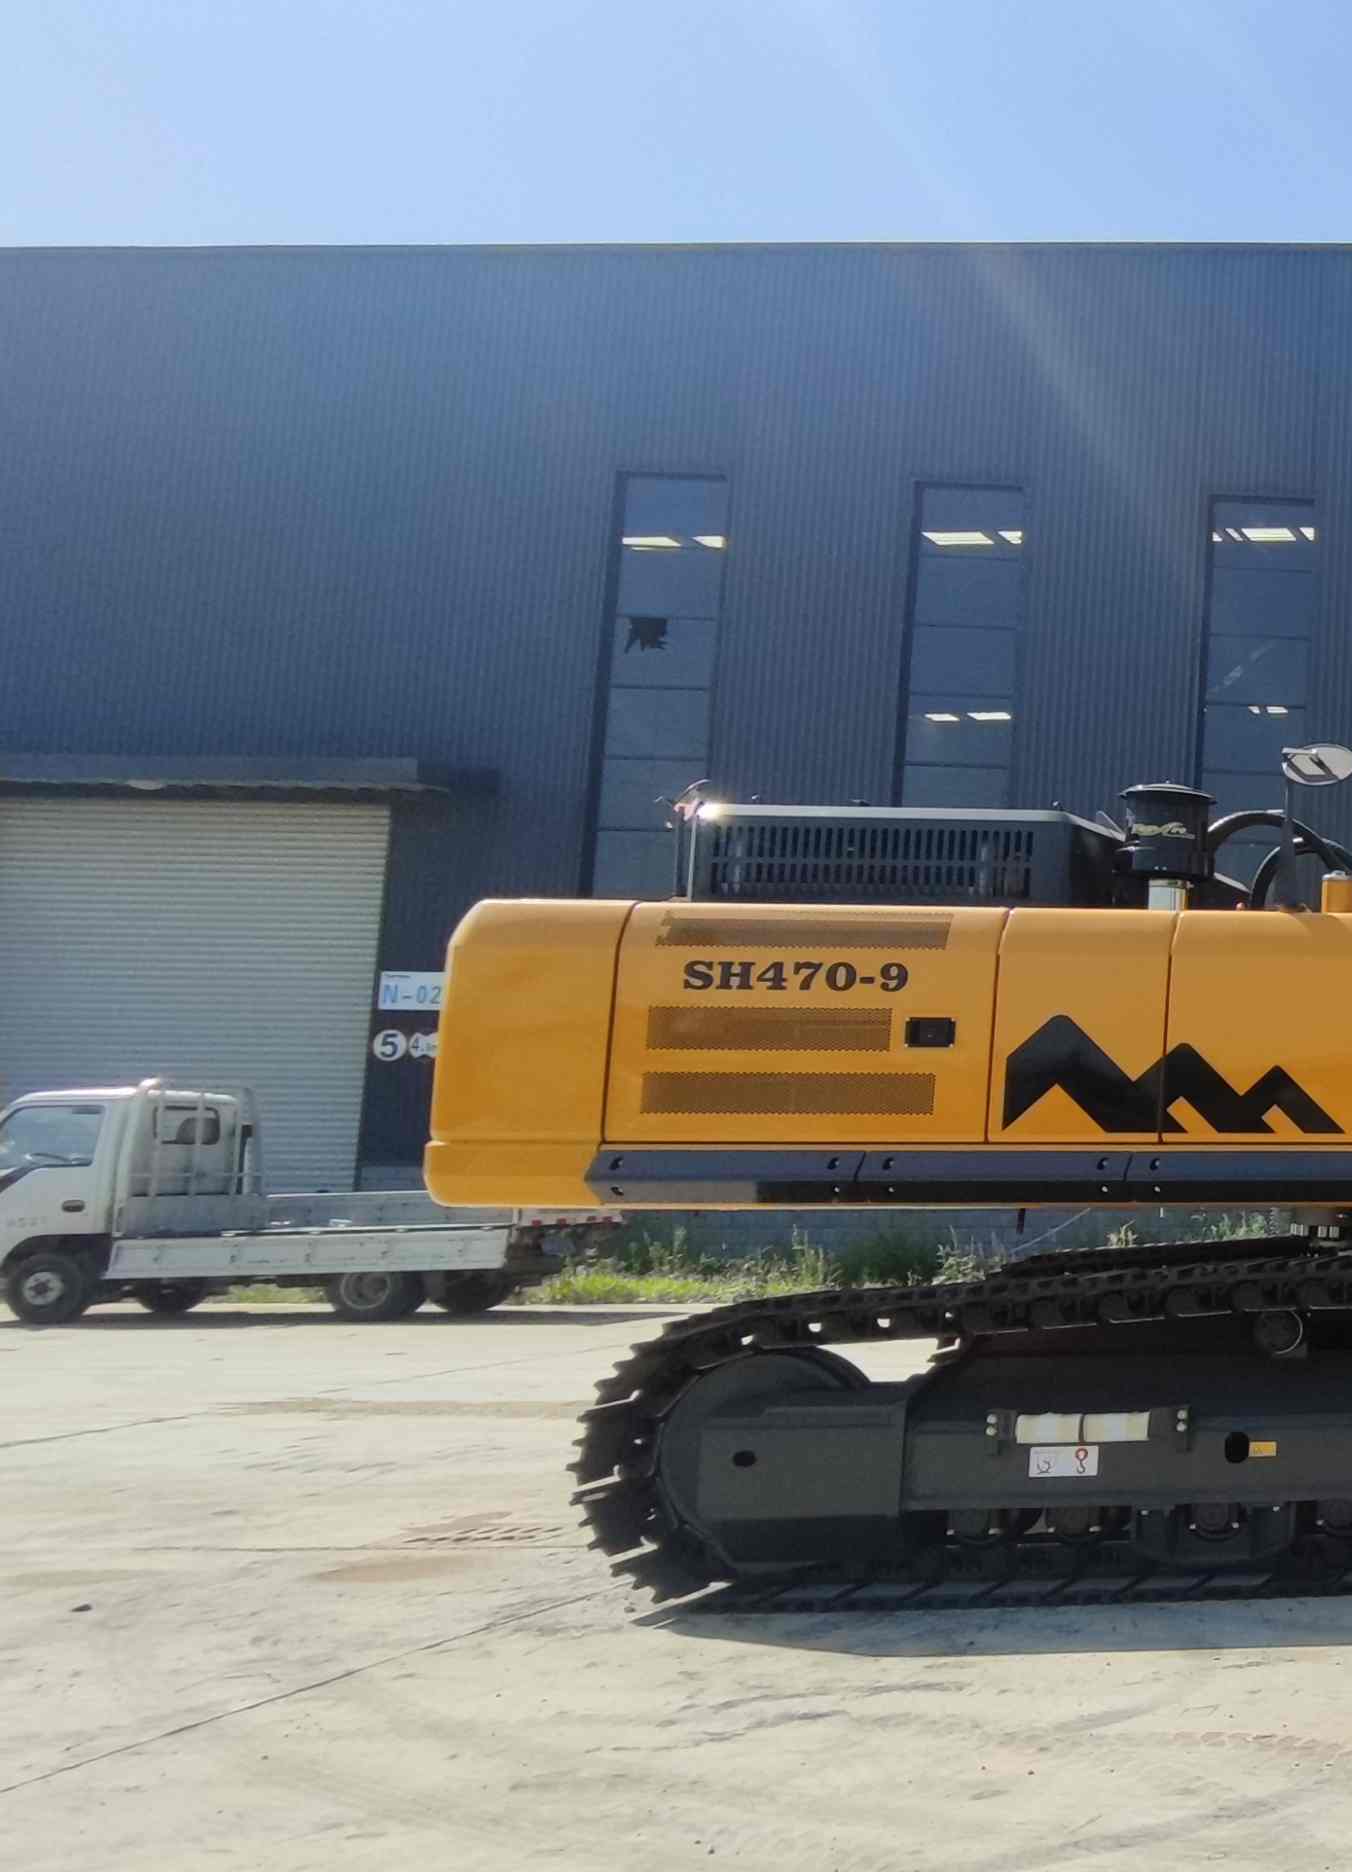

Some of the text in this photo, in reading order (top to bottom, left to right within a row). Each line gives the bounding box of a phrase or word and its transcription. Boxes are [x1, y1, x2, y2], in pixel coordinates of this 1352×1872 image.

[683, 960, 909, 992] SH470-9
[383, 984, 442, 1004] N-02
[380, 1032, 399, 1058] 5
